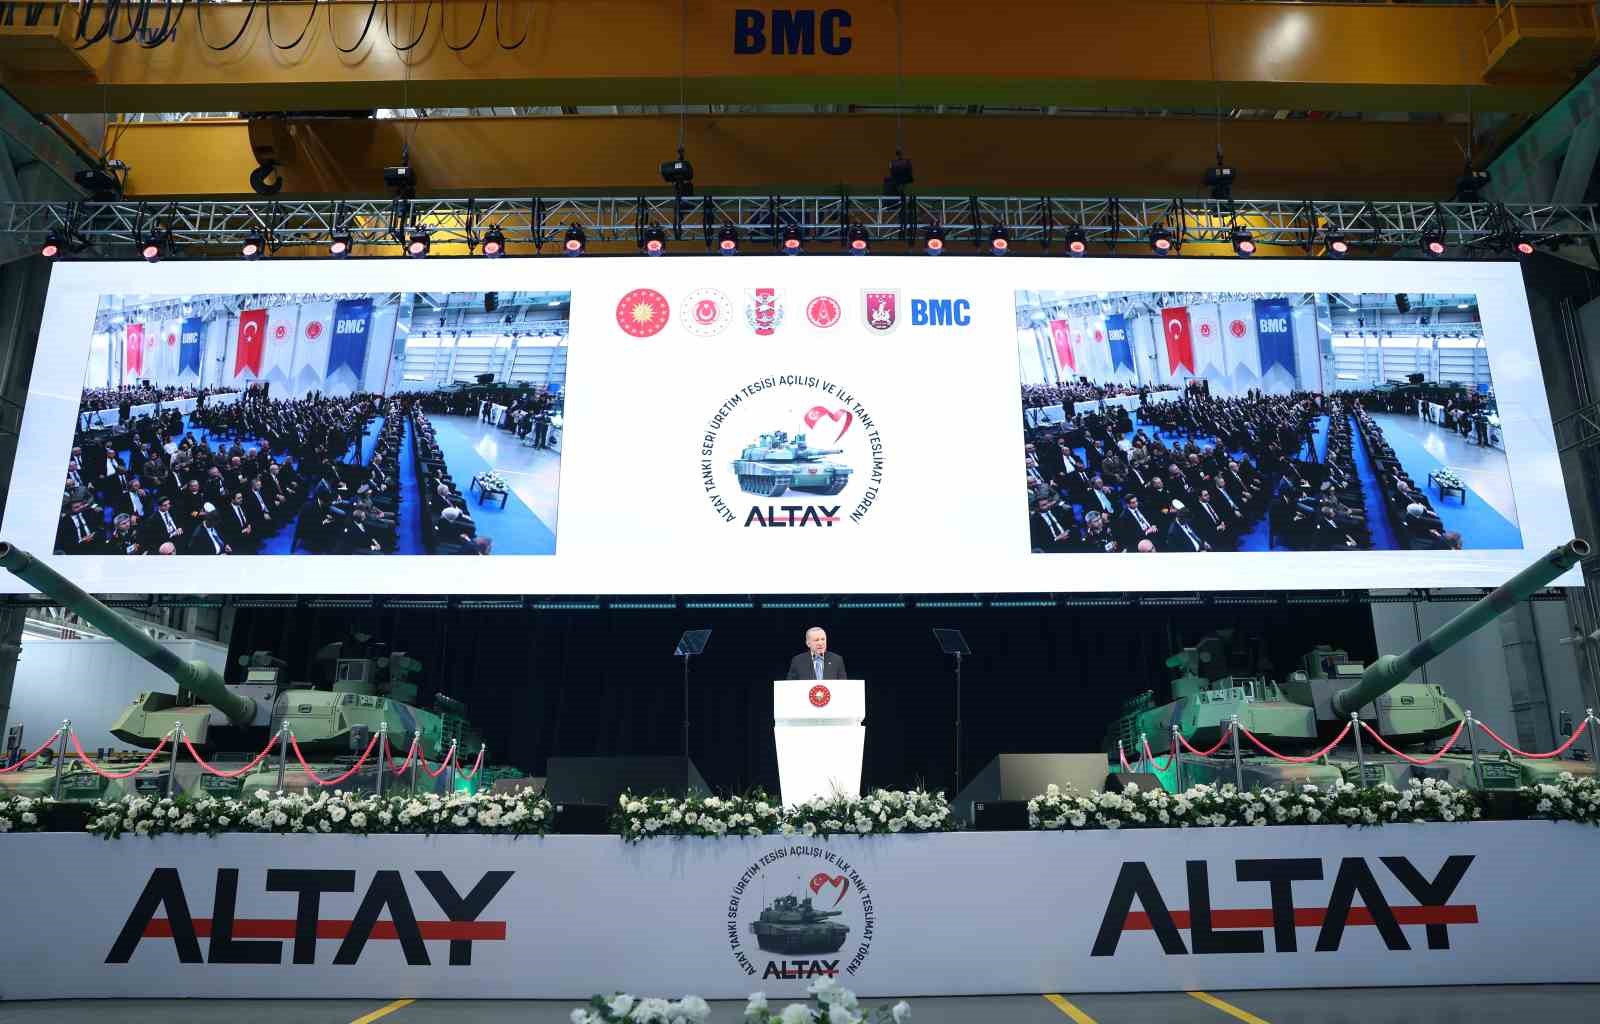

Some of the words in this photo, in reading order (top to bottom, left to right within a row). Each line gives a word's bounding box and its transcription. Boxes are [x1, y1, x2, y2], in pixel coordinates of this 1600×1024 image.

[734, 9, 852, 55] BMC
[911, 299, 970, 326] BMC
[336, 319, 365, 334] BMC
[1260, 318, 1287, 333] BMC
[823, 381, 838, 394] VE
[836, 390, 853, 405] İLK
[851, 403, 875, 430] TANK
[702, 459, 716, 493] TANKI
[710, 496, 736, 522] ALTAY
[744, 506, 841, 527] ALTAY
[825, 851, 839, 862] VE
[836, 858, 850, 872] İLK
[848, 870, 867, 893] TANK
[104, 868, 515, 965] ALTAY
[1090, 855, 1478, 956] ALTAY
[728, 918, 741, 951] TANKI
[734, 951, 757, 976] ALTAY
[762, 960, 840, 980] ALTAY
